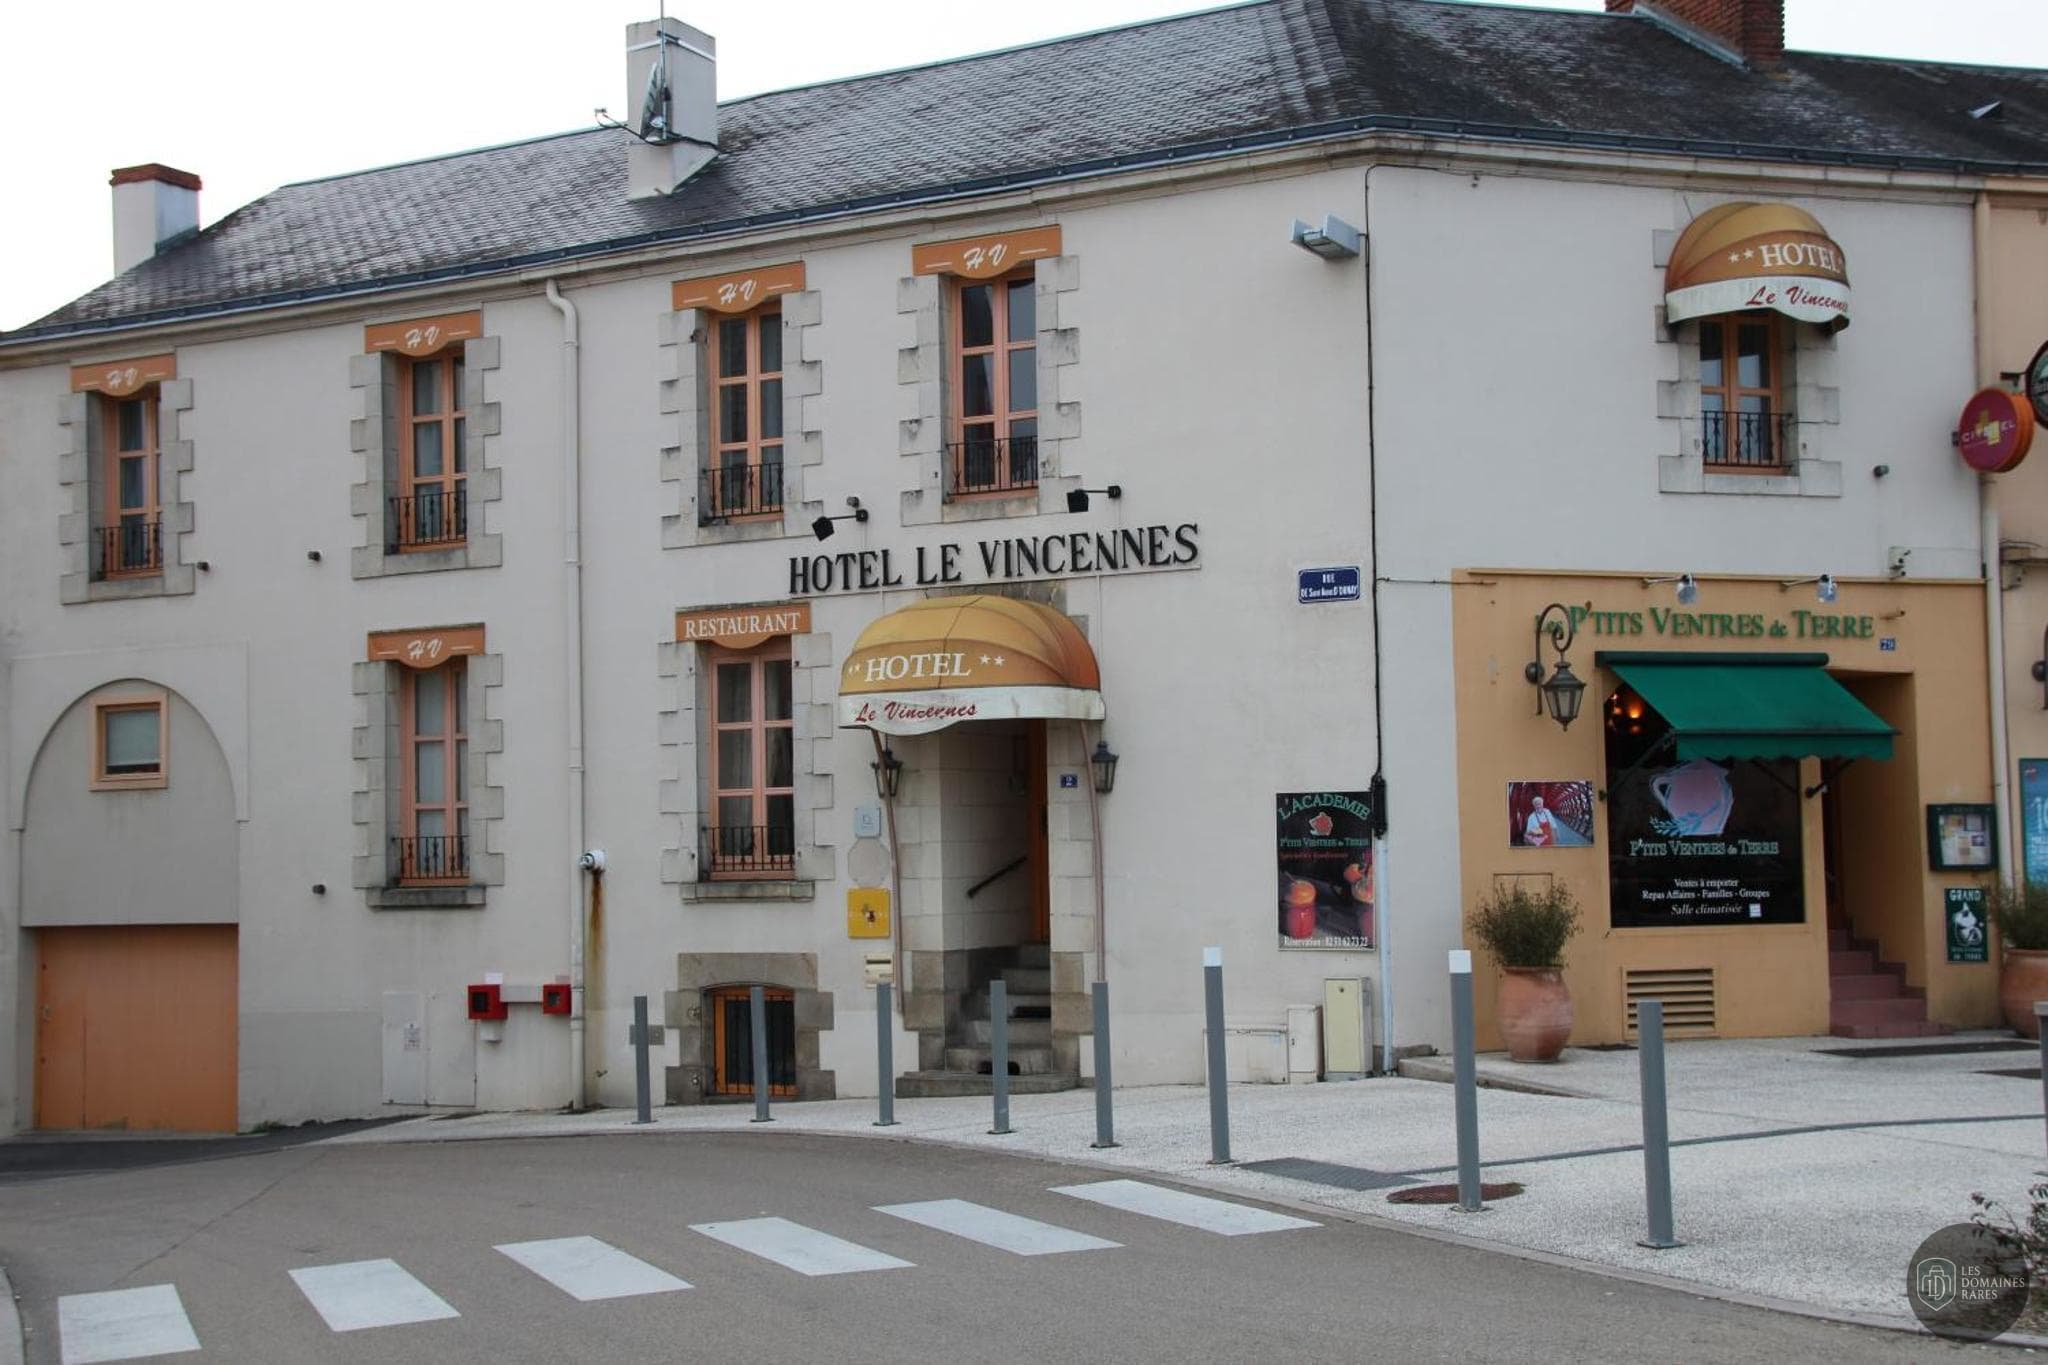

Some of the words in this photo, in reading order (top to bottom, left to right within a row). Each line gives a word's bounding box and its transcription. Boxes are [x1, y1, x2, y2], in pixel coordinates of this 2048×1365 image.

[1759, 242, 1840, 274] HOTEL
[1745, 285, 1776, 306] Le
[789, 548, 903, 595] HOTEL
[916, 543, 962, 585] LE
[979, 523, 1200, 579] VINCENNES
[685, 611, 800, 639] RESTAURANT
[1649, 606, 1763, 638] VENTRES
[1791, 609, 1875, 639] TERRE
[864, 652, 972, 683] HOTEL
[855, 702, 876, 723] Le
[884, 700, 978, 721] Vincennes
[1668, 839, 1725, 856] VENTRES
[1738, 838, 1779, 856] TERRE
[1642, 890, 1665, 902] Repas
[1666, 888, 1696, 900] Affaires
[1702, 888, 1734, 899] Familles
[1739, 888, 1770, 900] Groupes
[1705, 879, 1740, 890] emporter
[1670, 902, 1694, 916] Salle
